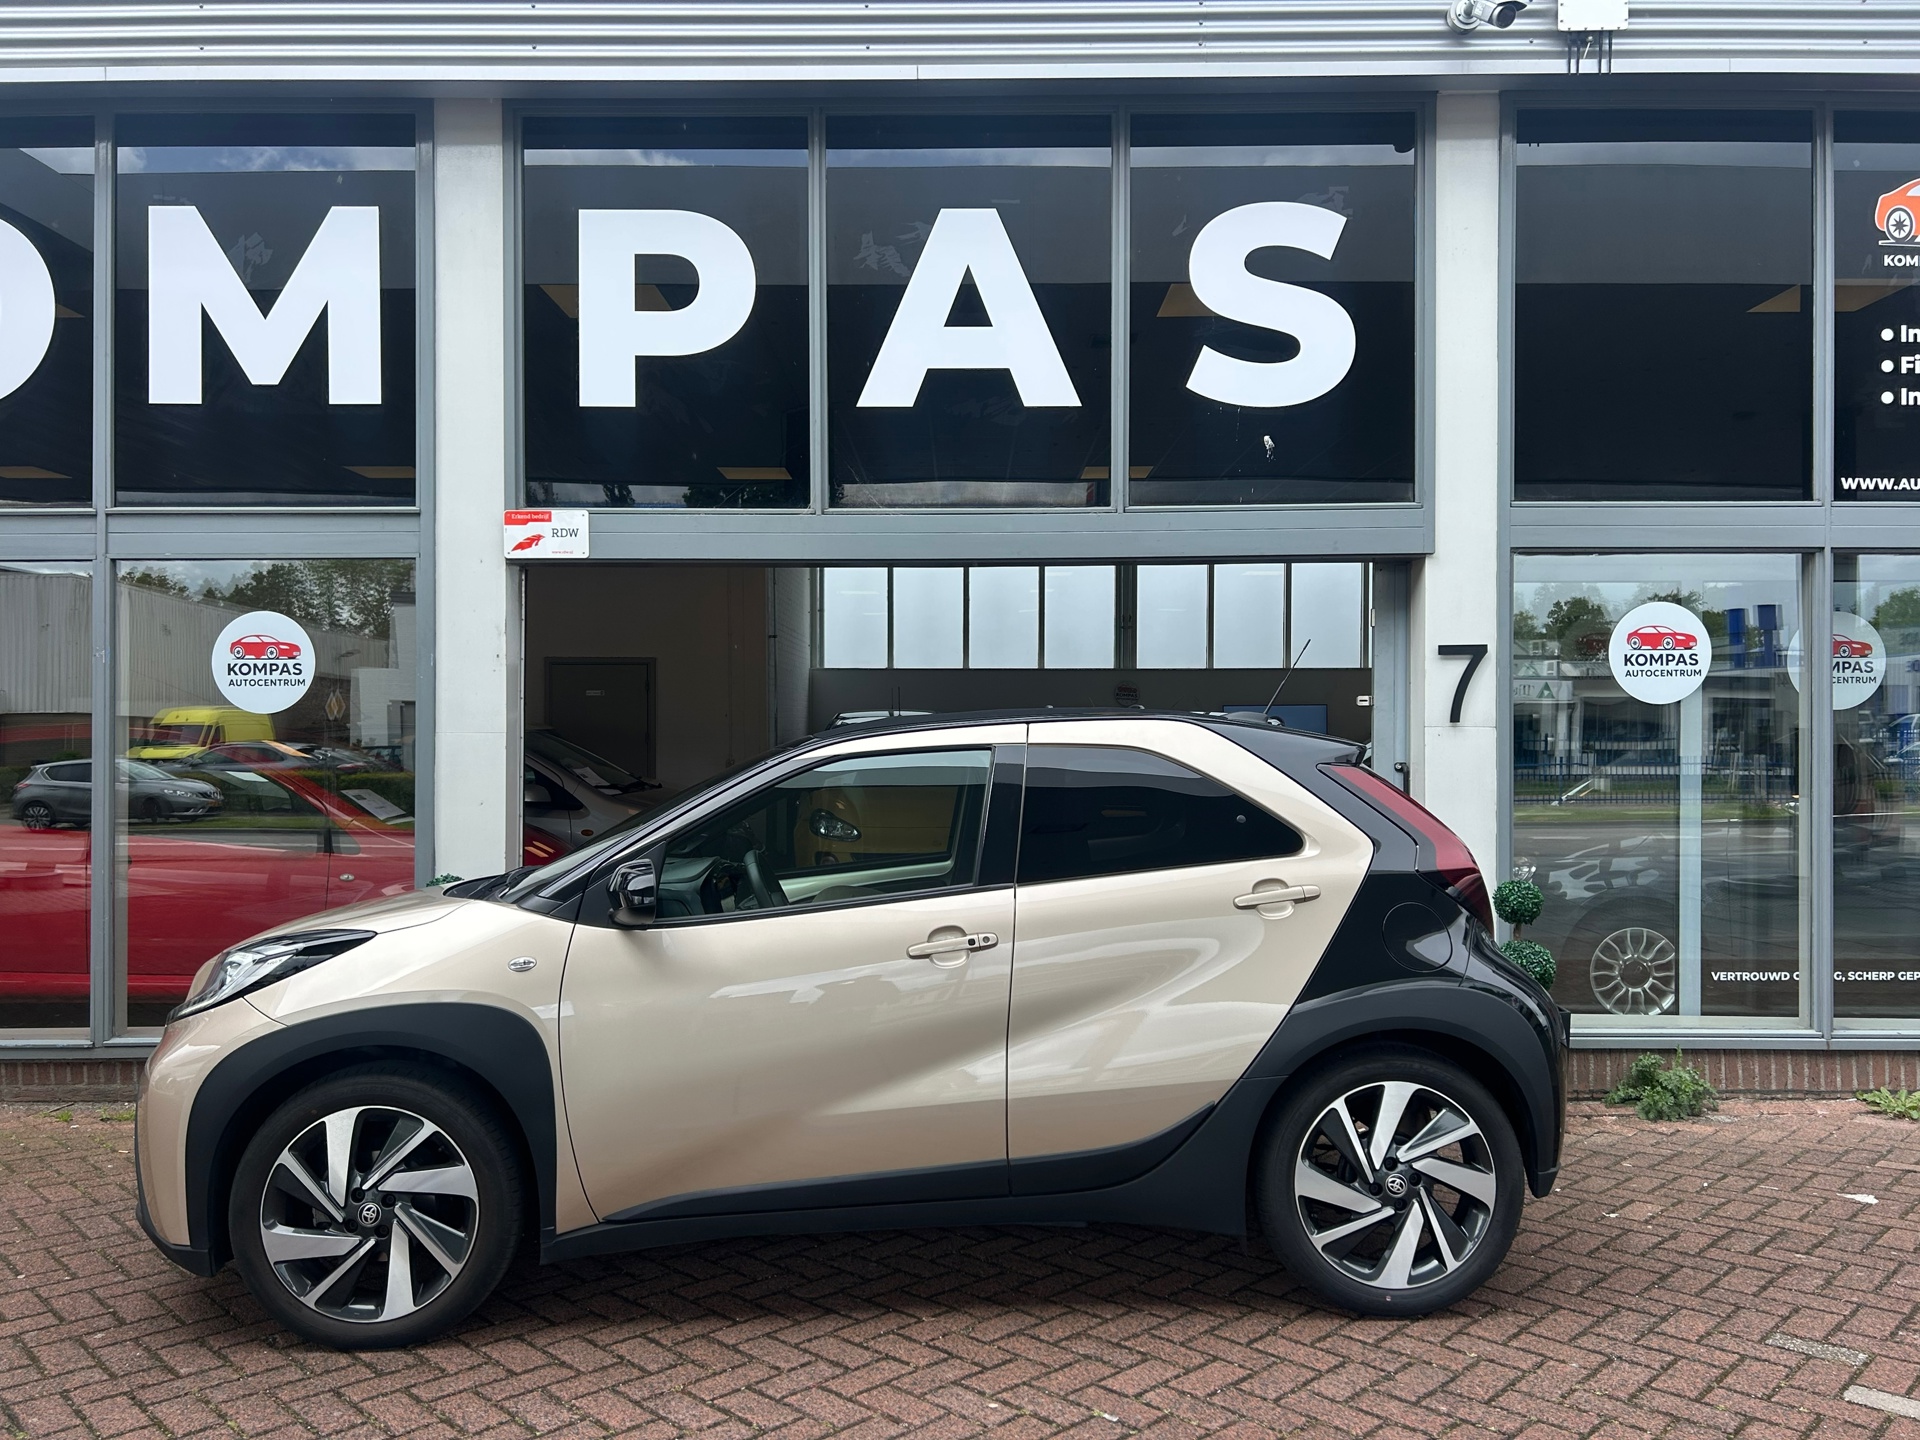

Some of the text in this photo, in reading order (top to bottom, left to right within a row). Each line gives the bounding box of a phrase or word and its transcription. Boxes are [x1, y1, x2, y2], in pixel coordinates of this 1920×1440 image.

[1883, 254, 1920, 267] KOM
[0, 201, 1357, 408] MPAS
[1900, 324, 1920, 343] In
[1900, 354, 1920, 374] Fi
[1900, 387, 1920, 406] In
[551, 528, 579, 538] RDW
[1624, 653, 1699, 666] KOMPAS
[227, 662, 303, 676] KOMPAS
[1625, 669, 1702, 677] AUTOCENTRUM
[228, 678, 306, 687] AUTOCENTRUM
[1438, 644, 1488, 723] 7
[1711, 971, 1790, 981] VERTROUWD
[1847, 971, 1896, 981] SCHERP
[1897, 971, 1920, 981] GEP
